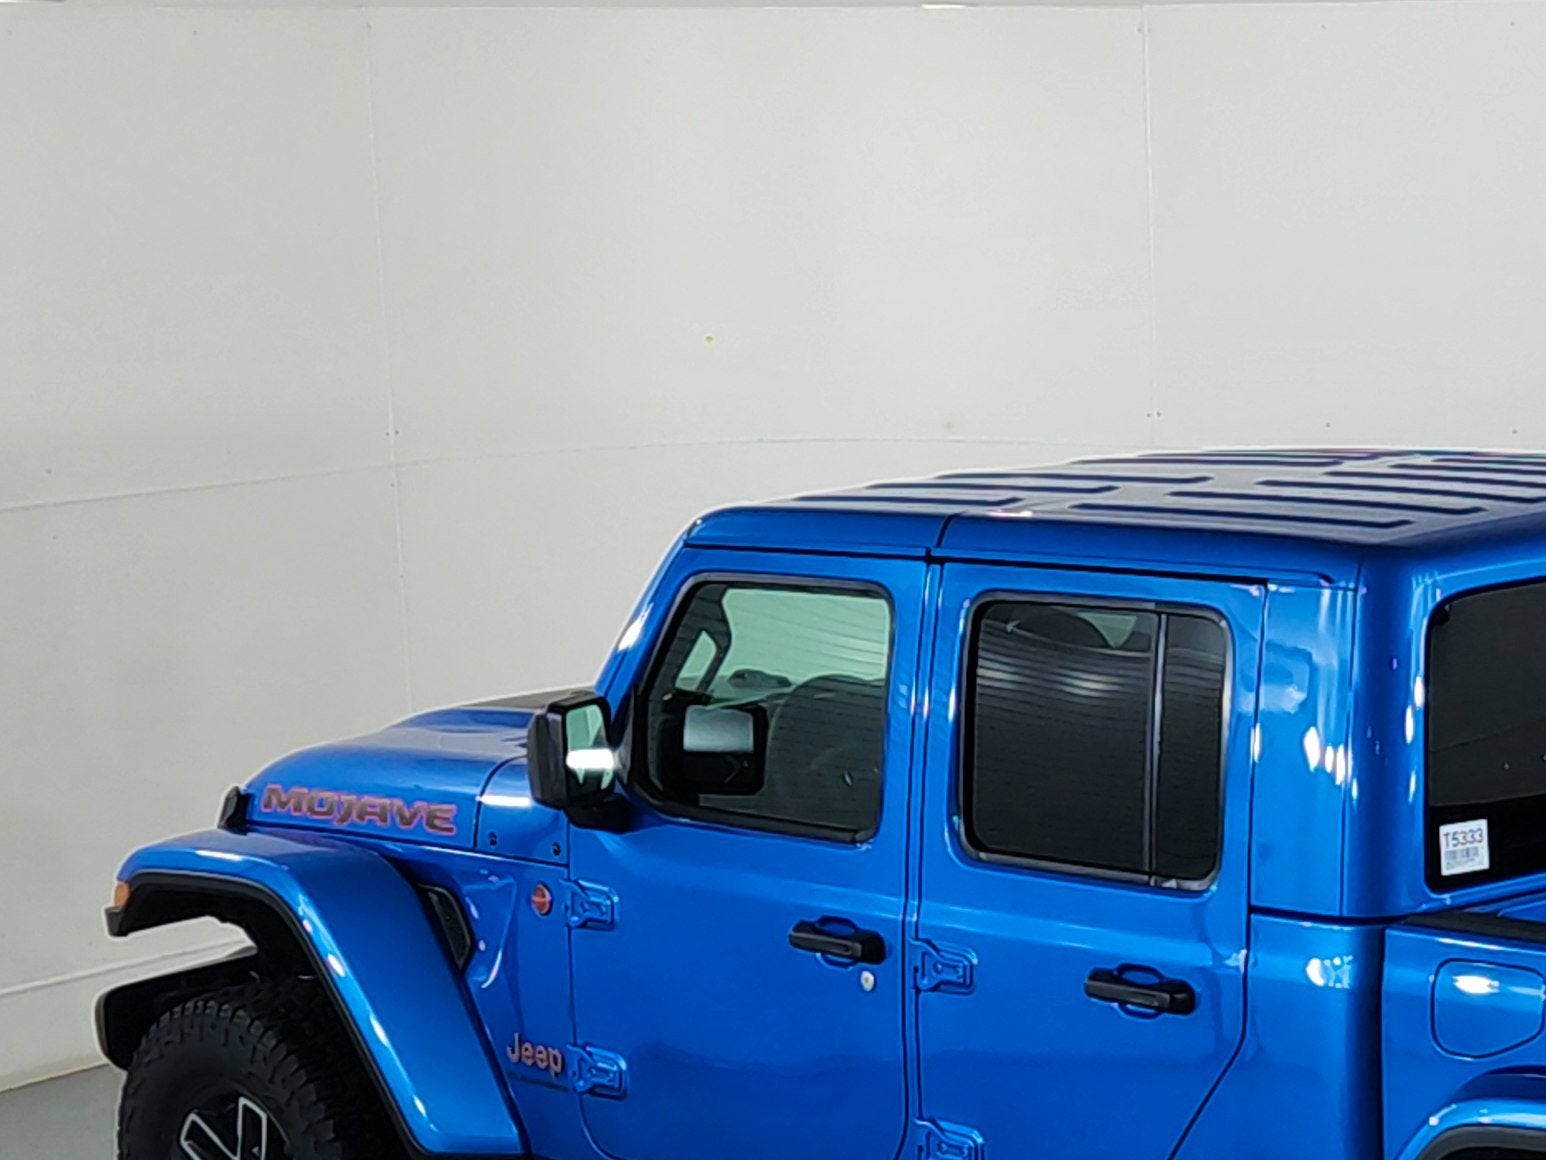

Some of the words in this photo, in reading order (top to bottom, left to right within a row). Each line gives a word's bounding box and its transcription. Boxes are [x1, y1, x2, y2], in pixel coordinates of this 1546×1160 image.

[260, 784, 458, 835] MOJAVE
[1443, 827, 1484, 849] T5333
[506, 1032, 562, 1079] Jeep
